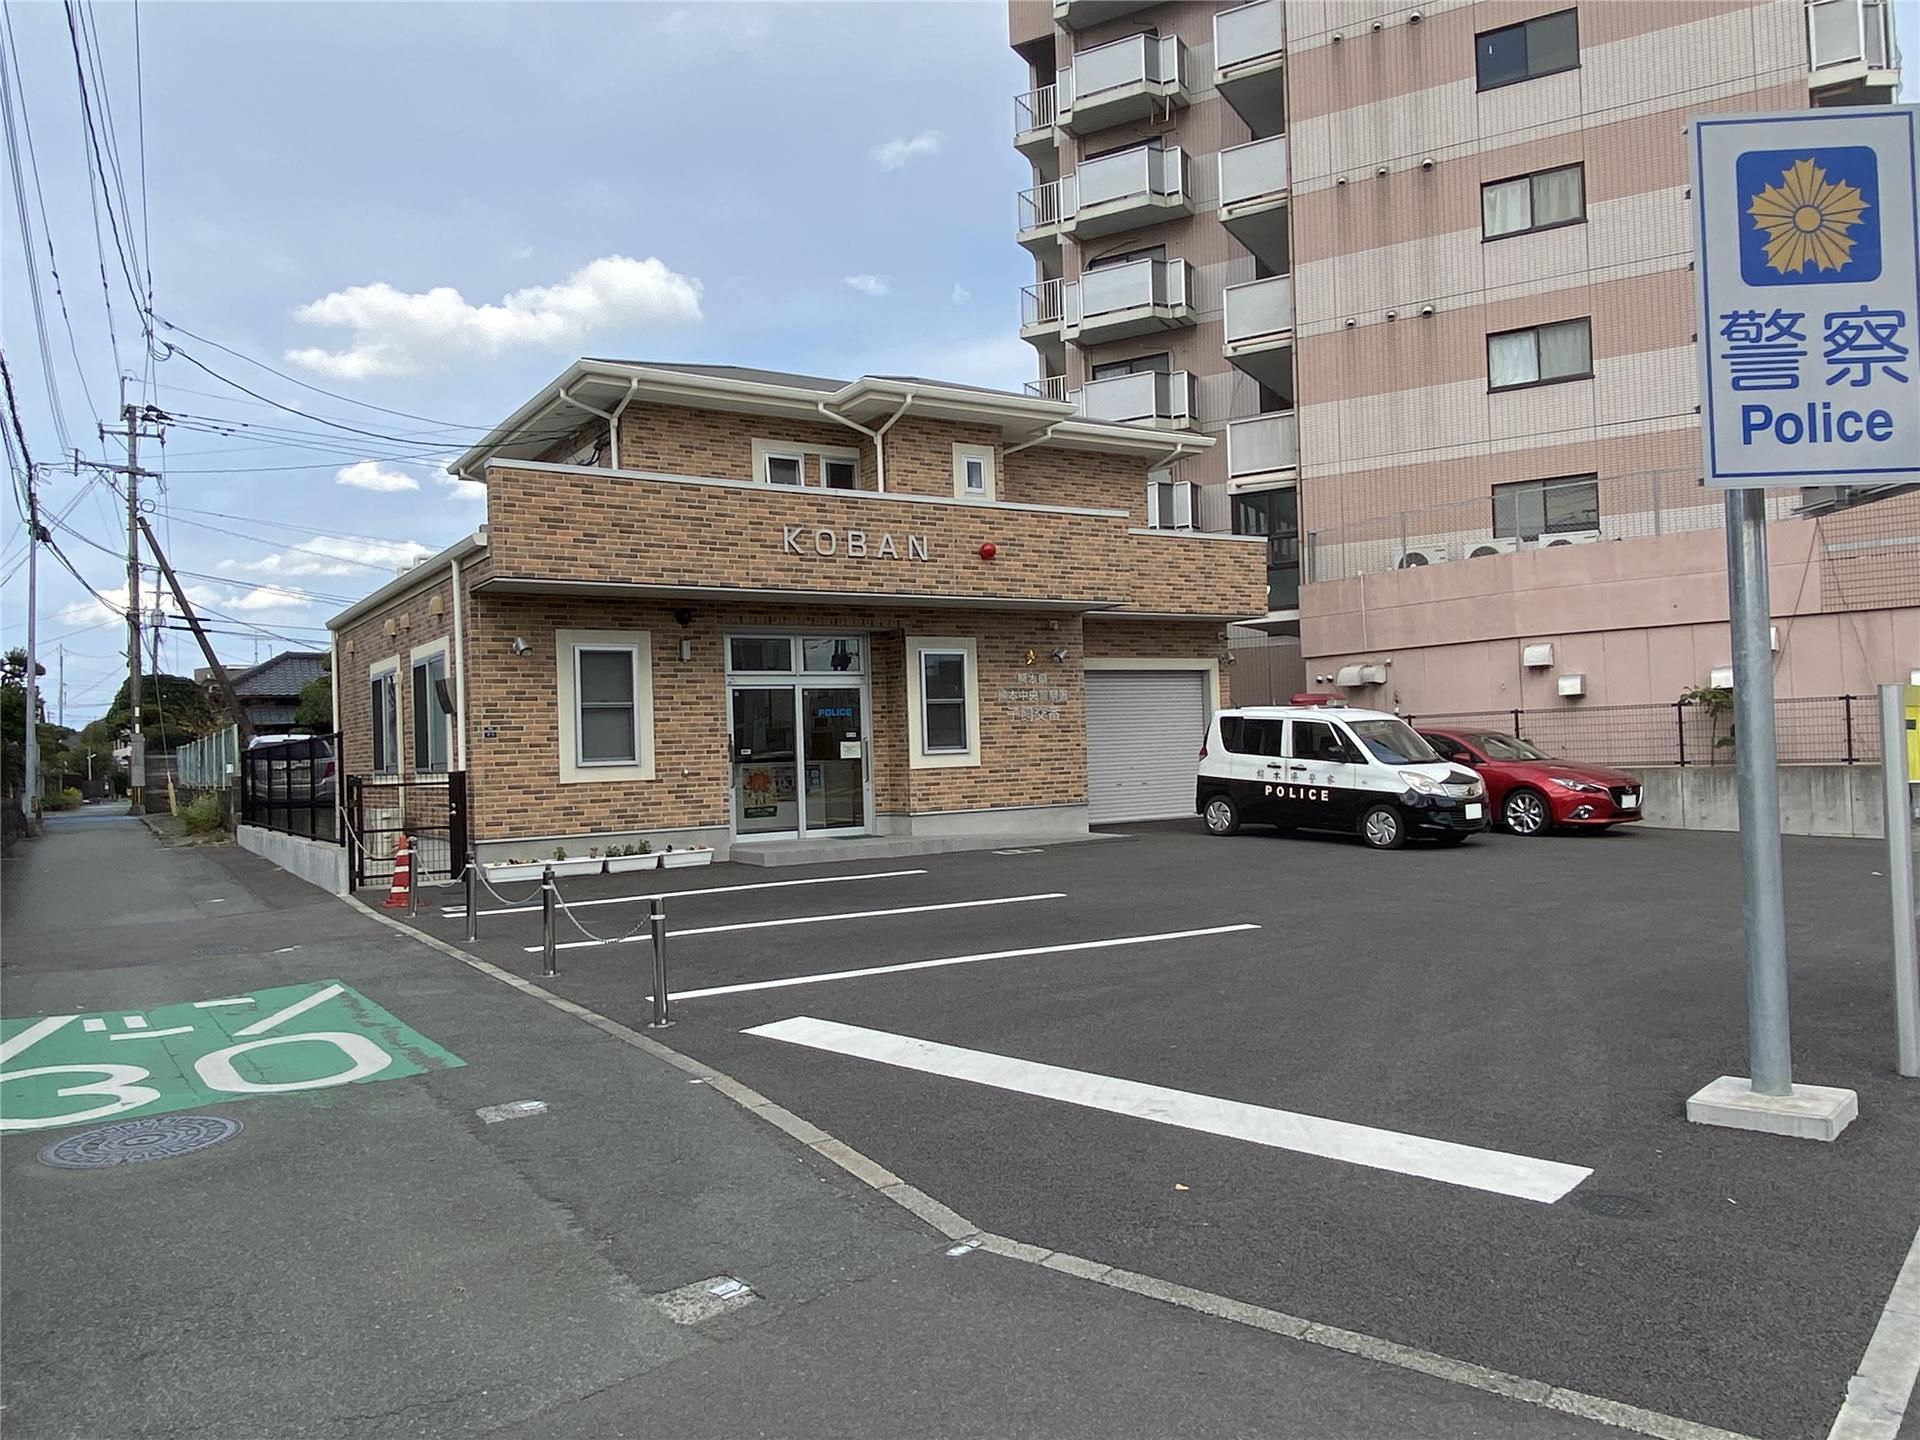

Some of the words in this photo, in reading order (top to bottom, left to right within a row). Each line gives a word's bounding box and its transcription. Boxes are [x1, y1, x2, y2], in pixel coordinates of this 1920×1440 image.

[1719, 304, 1910, 392] 警察
[1741, 402, 1894, 446] Police
[782, 525, 929, 562] KOBAN
[817, 707, 853, 717] POLICE
[997, 688, 1069, 703] 本中央察署
[1265, 785, 1329, 801] POLICE
[0, 1031, 393, 1130] 30
